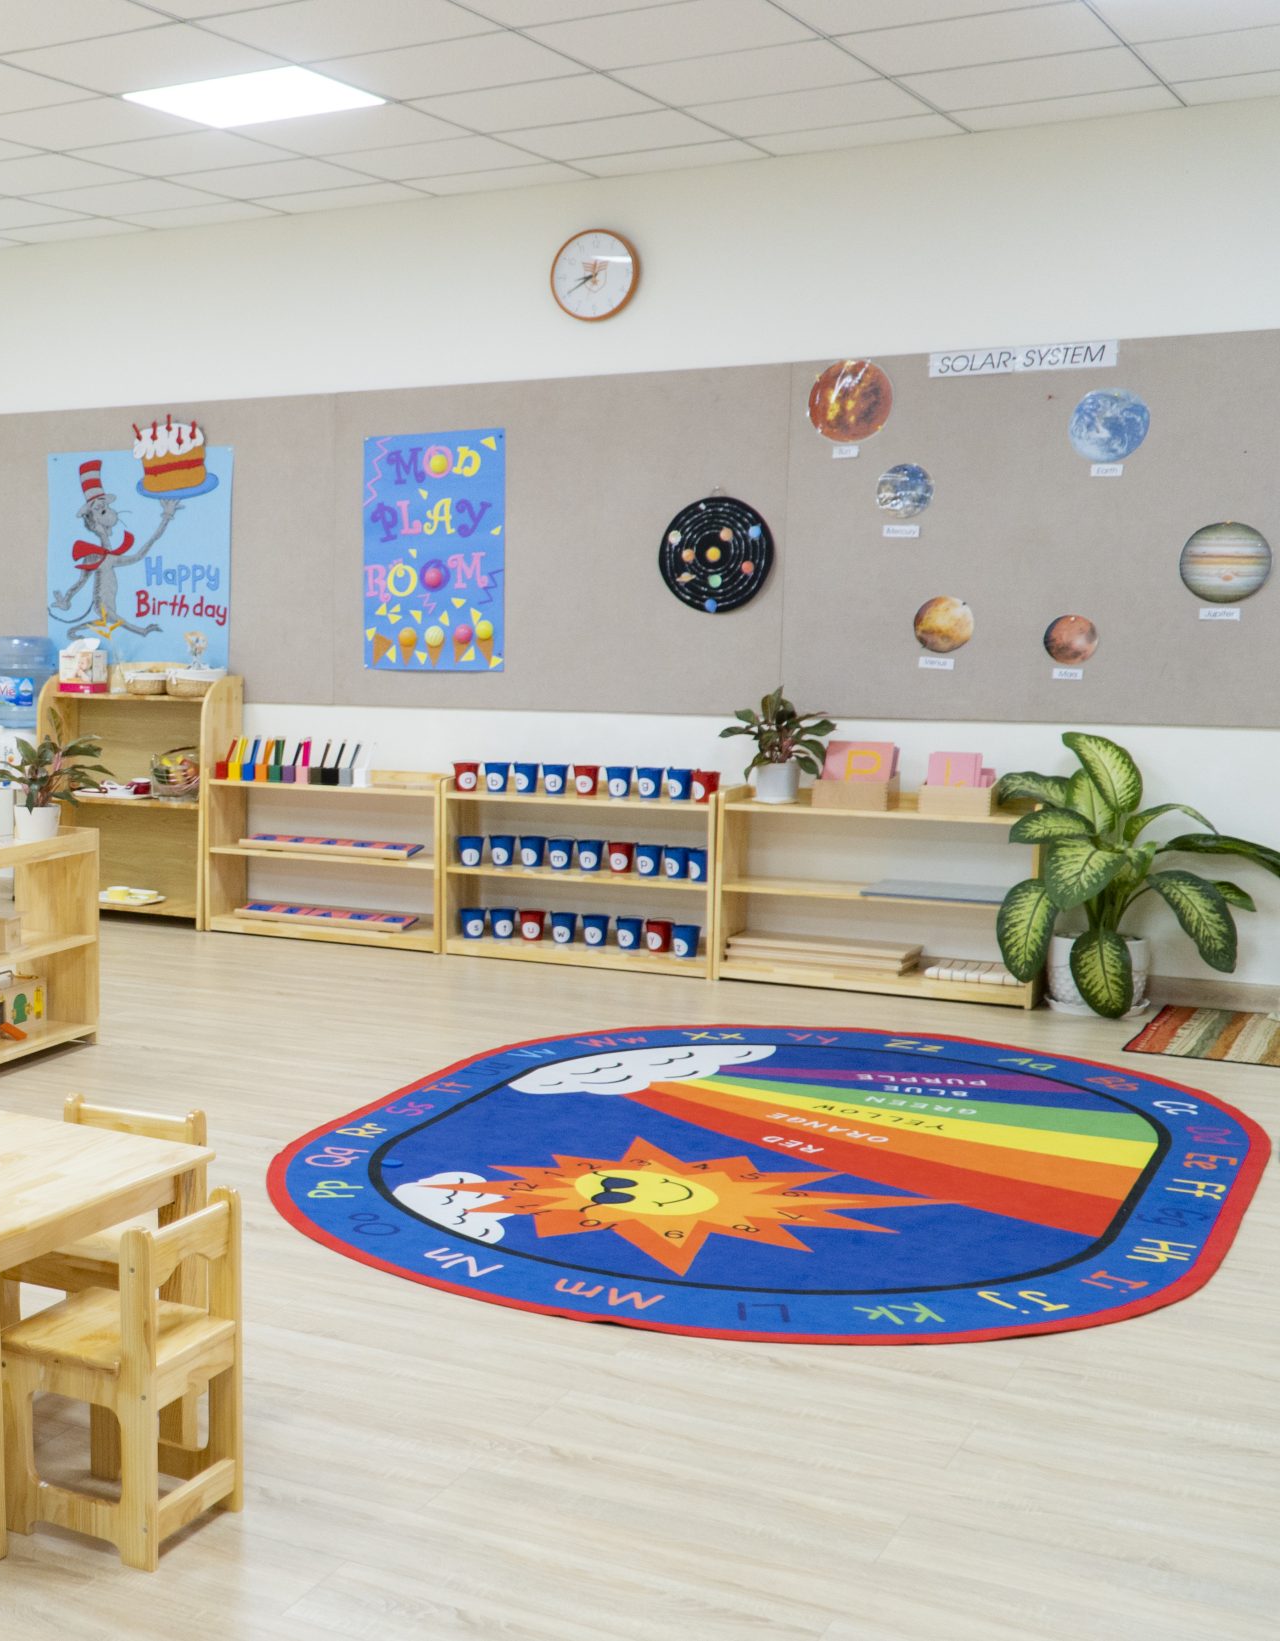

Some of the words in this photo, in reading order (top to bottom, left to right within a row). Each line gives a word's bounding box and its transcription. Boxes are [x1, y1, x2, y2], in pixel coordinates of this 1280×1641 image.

[1023, 344, 1106, 368] SYSTEM
[386, 445, 481, 485] MOD
[371, 498, 492, 543] PLAY
[886, 527, 918, 537] Mercury
[144, 555, 220, 593] Happy
[364, 551, 489, 603] ROOM
[135, 589, 227, 626] Birthday
[855, 1072, 988, 1086] PURPLE
[883, 1084, 969, 1098] BLUE
[812, 1104, 945, 1131] YELLOW
[864, 1095, 978, 1116] GREEN
[766, 1112, 890, 1143] ORANGE
[761, 1135, 825, 1154] RED
